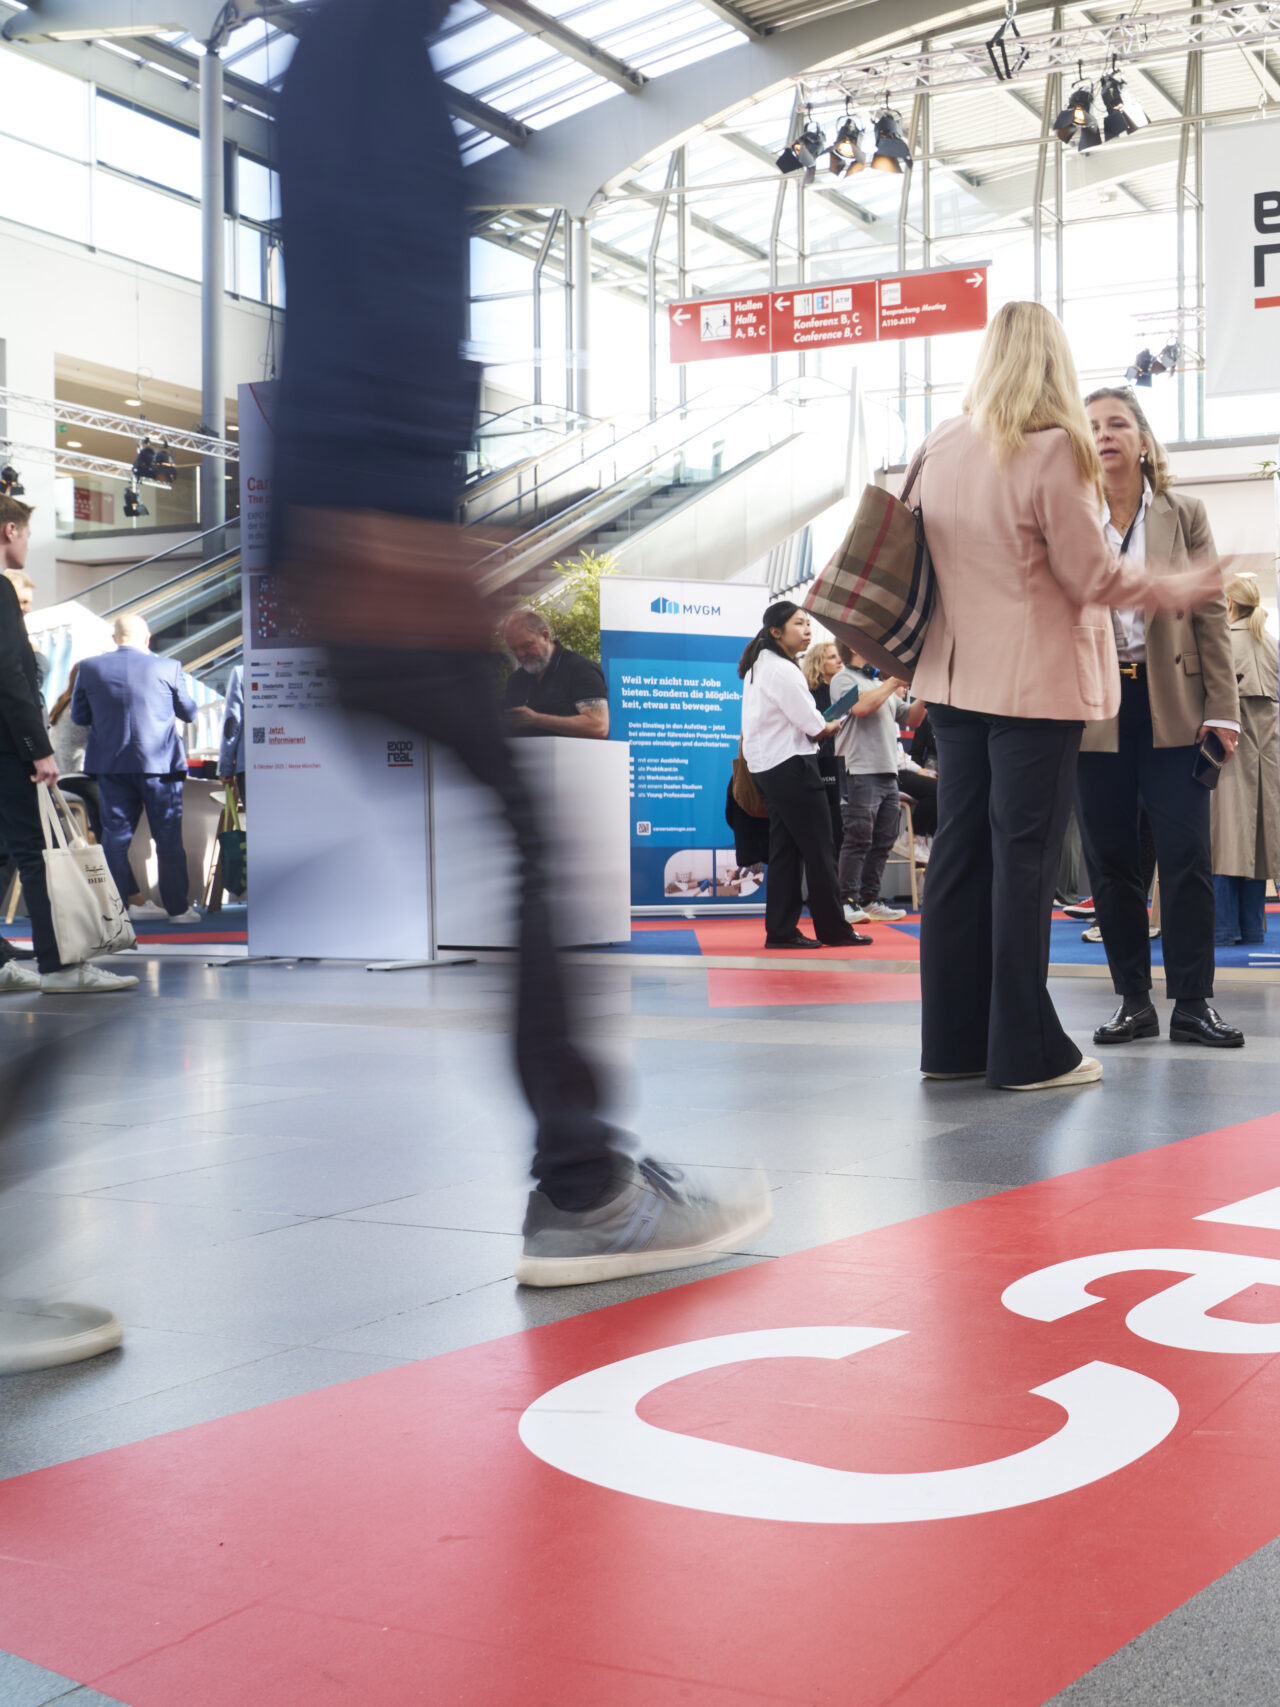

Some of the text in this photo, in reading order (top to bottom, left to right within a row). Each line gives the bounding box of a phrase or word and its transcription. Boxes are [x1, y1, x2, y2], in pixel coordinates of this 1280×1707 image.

[734, 300, 763, 312] Hallen
[735, 313, 757, 325] Halls
[793, 313, 860, 330] Konferenz B, C
[735, 326, 766, 339] A, B, C
[793, 326, 862, 343] Conference B, C
[247, 477, 273, 491] Car
[683, 604, 721, 616] MVGM
[621, 675, 642, 685] Weil
[643, 676, 657, 685] wir
[659, 676, 682, 686] nicht
[700, 677, 721, 687] Jobs
[621, 687, 651, 697] bieten.
[652, 688, 689, 698] Sondern
[690, 689, 704, 698] die
[621, 700, 722, 712] keit, etwas zu bewegen.
[642, 722, 665, 730] Einstieg
[684, 723, 707, 731] Aufstieg
[268, 736, 306, 745] informieren!
[667, 731, 695, 739] führenden
[696, 731, 719, 740] Property
[387, 741, 413, 753] expo
[653, 740, 681, 748] einsteigen
